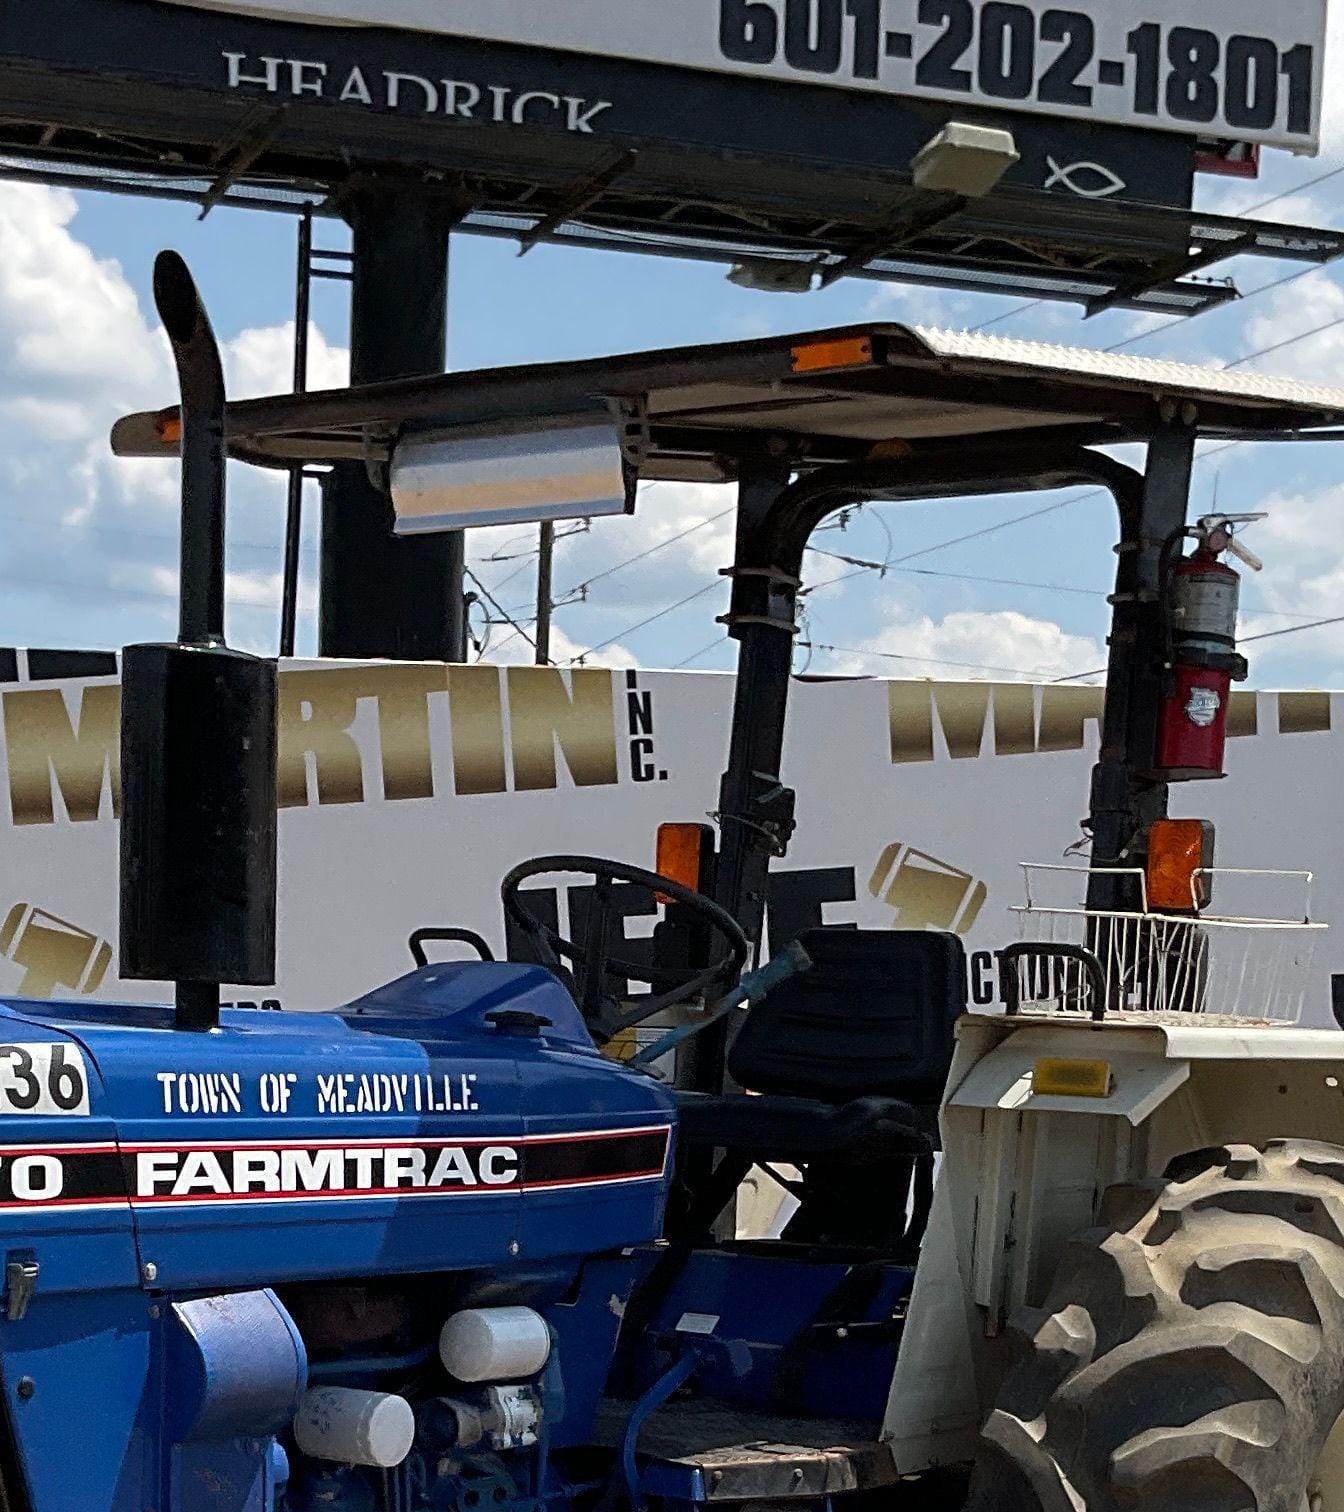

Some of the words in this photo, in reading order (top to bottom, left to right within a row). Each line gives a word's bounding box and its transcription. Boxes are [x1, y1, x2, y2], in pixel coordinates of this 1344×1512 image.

[222, 51, 613, 133] HEADRICK
[718, 0, 1316, 134] 601-202-1801
[2, 666, 619, 826] MRTIN
[157, 1072, 241, 1114] TOWN
[260, 1072, 298, 1113] OF
[316, 1072, 479, 1114] MEADVILLE
[136, 1145, 518, 1197] FARMTRAC
